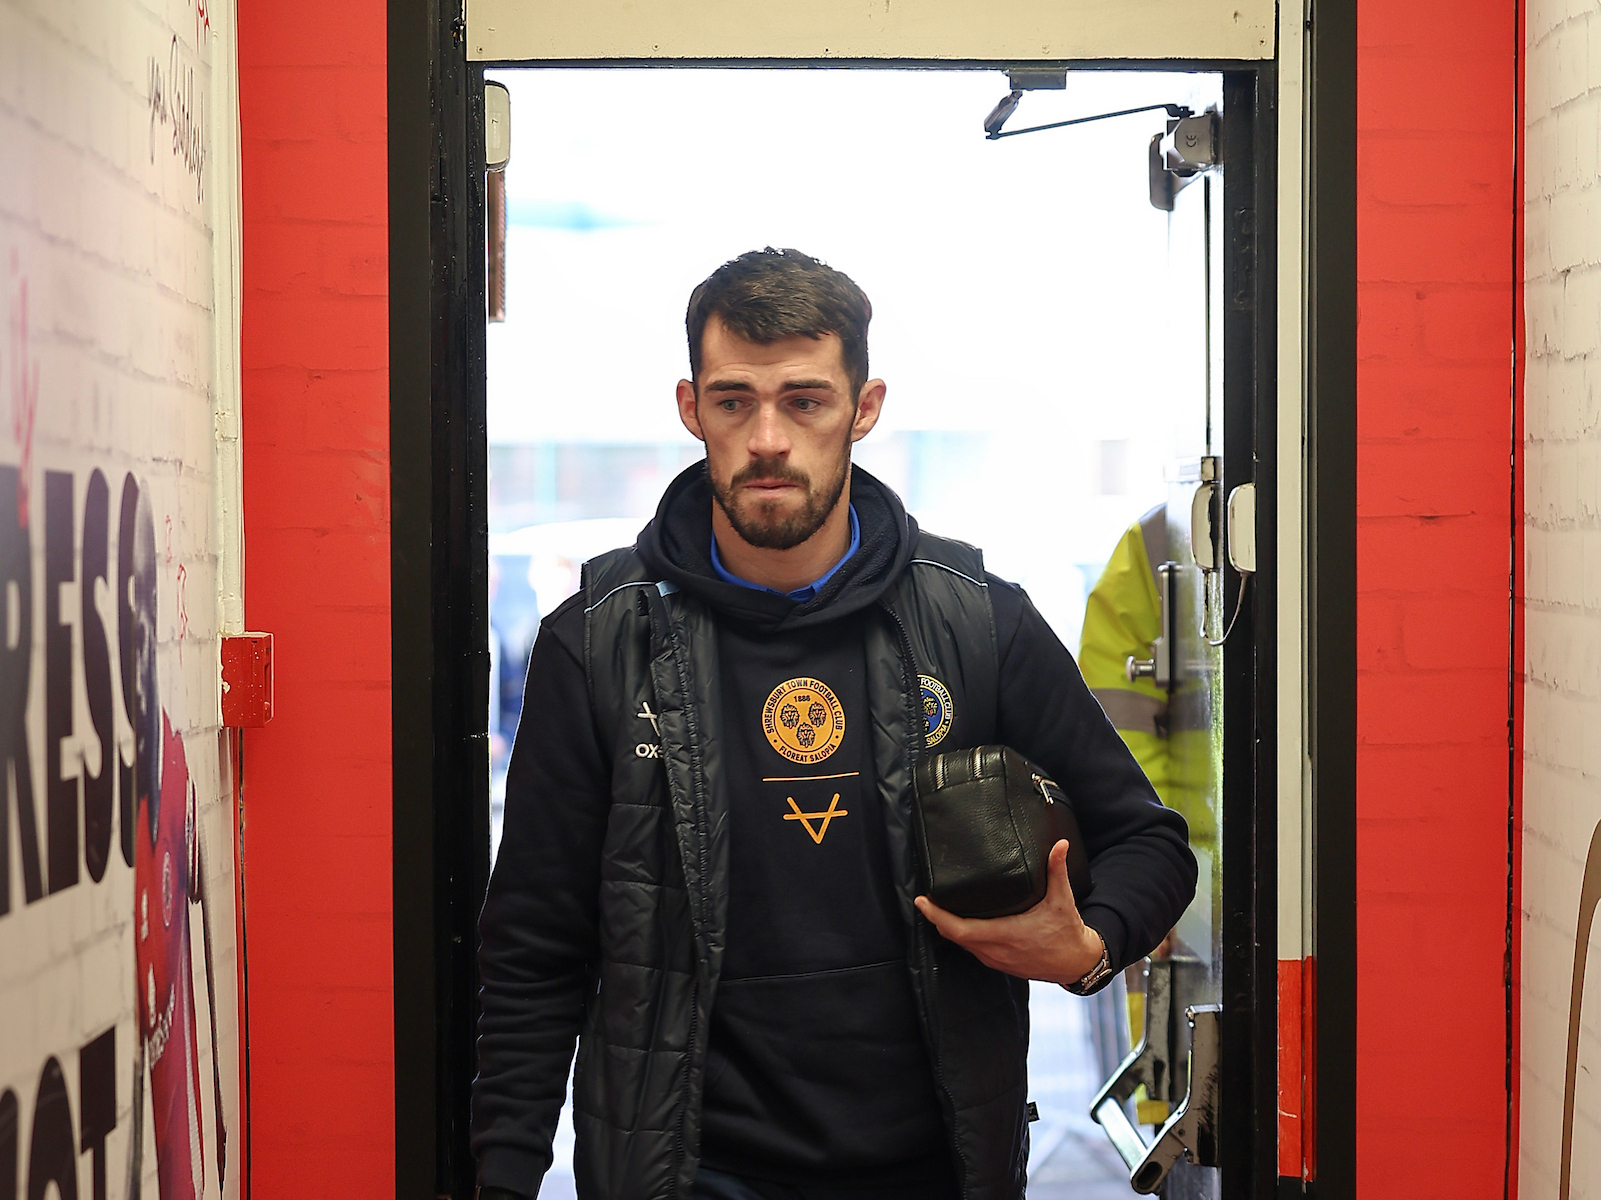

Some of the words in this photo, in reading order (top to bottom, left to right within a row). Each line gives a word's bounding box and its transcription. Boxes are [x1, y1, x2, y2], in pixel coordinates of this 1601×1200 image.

[920, 677, 949, 703] FOOTBALL
[765, 685, 787, 734] SHREWSBURY
[786, 679, 808, 690] TOWN
[809, 680, 839, 710] FOOTBALL
[834, 710, 844, 730] CLUB
[926, 724, 948, 745] SALOPIA
[779, 745, 808, 763] FLOREAT
[809, 743, 836, 762] SALOPIA
